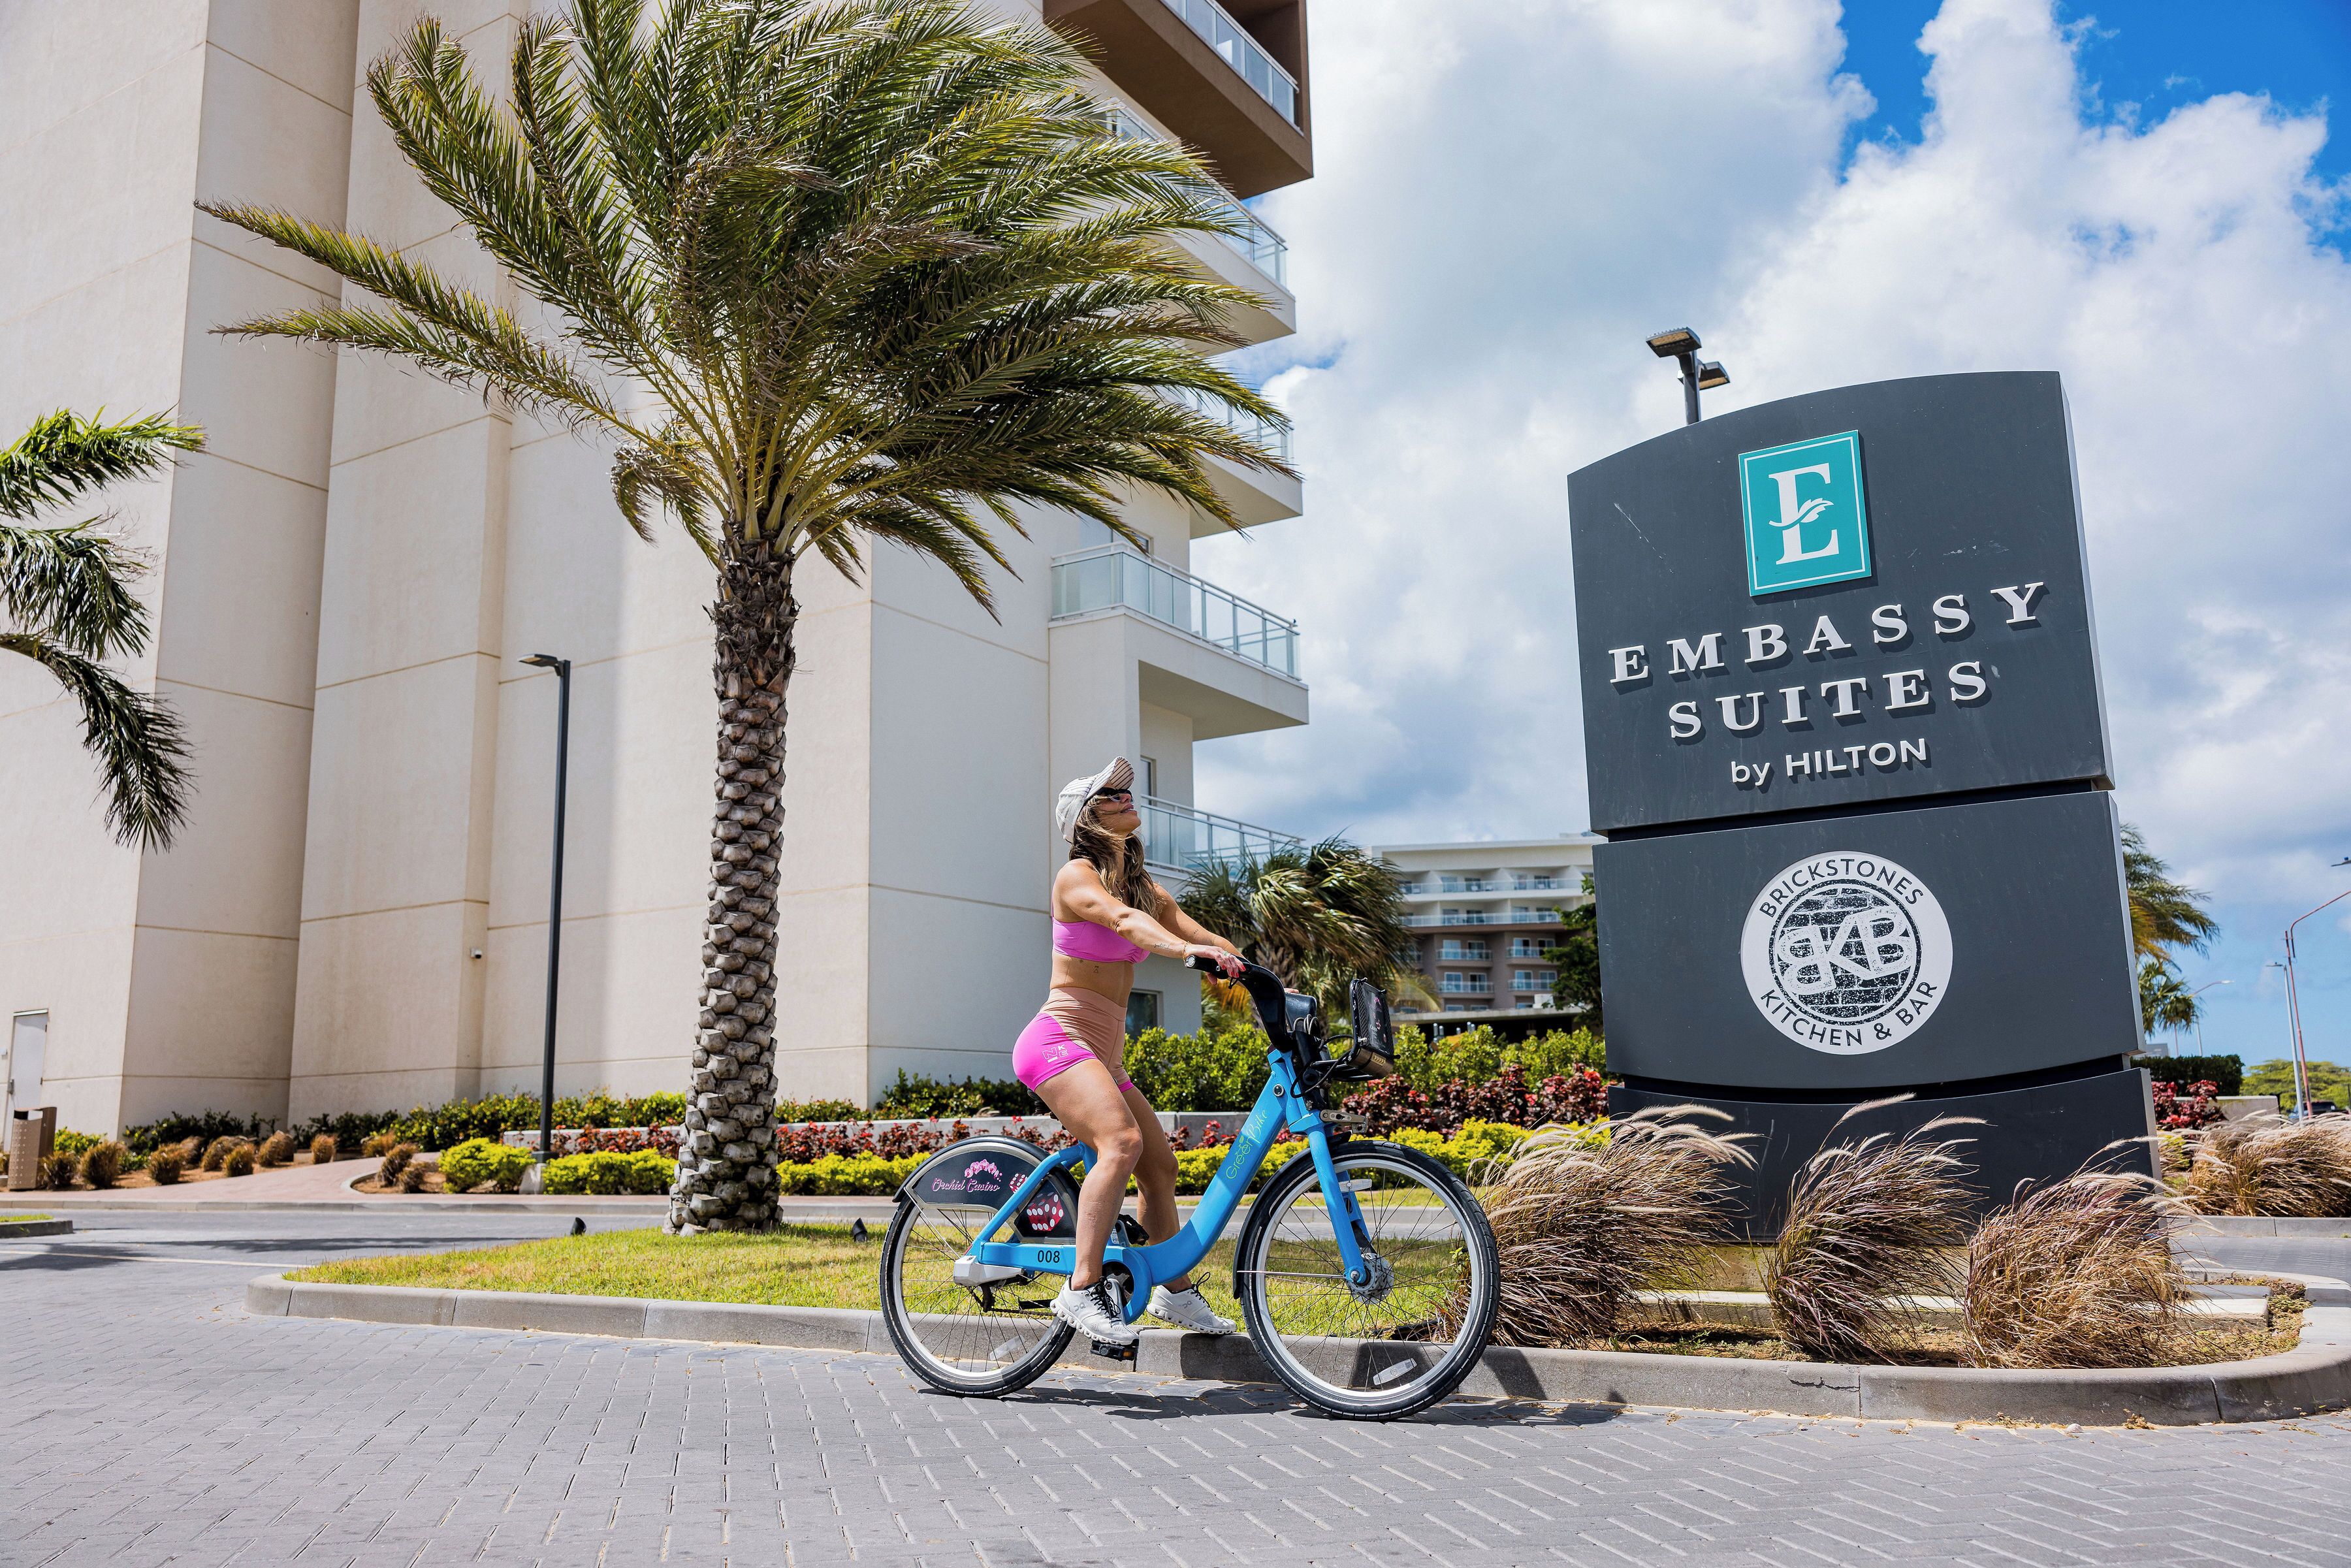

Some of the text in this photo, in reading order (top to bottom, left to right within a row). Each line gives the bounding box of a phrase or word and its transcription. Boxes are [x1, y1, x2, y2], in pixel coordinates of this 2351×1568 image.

[1768, 462, 1840, 565] E
[1608, 581, 2044, 683] EMBASSY
[1669, 661, 1986, 738] SUITES
[1731, 738, 1927, 786] by HILTON
[1759, 858, 1924, 918] BRICKSTONES
[1760, 982, 1938, 1047] KITCHEN & BAR
[931, 1178, 1000, 1192] Orchid Casino
[1037, 1249, 1060, 1264] 008
